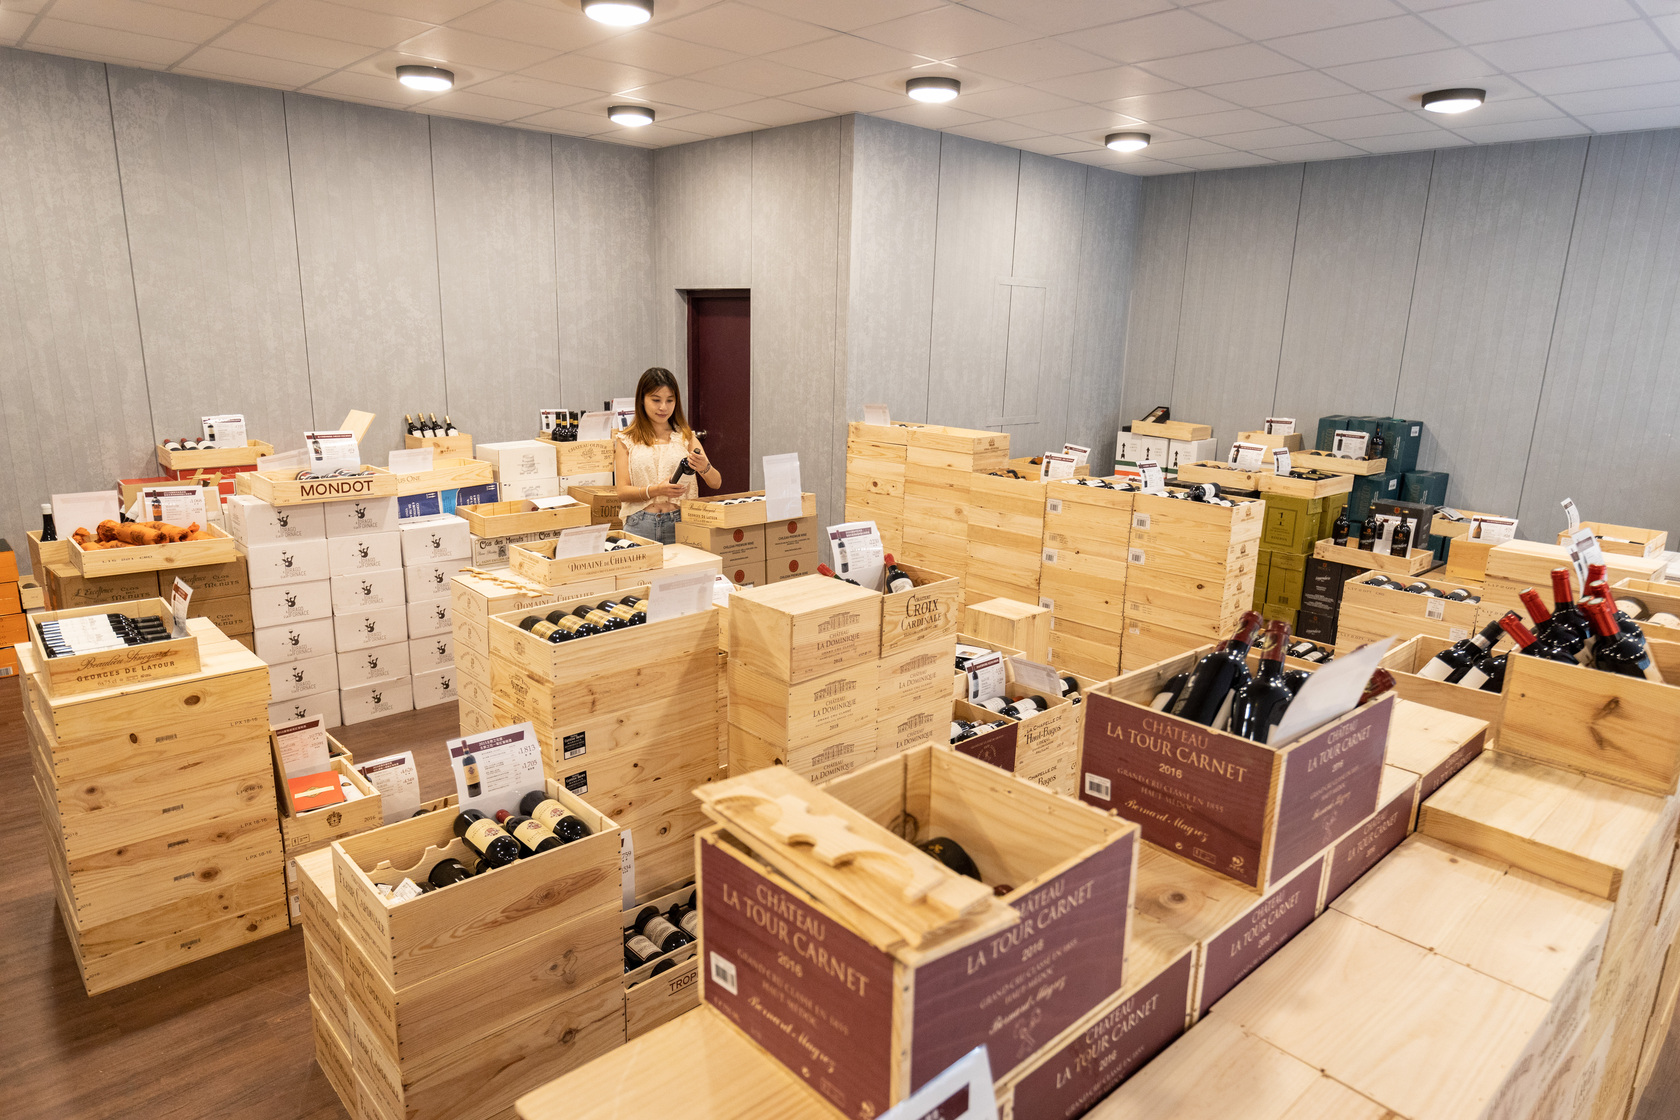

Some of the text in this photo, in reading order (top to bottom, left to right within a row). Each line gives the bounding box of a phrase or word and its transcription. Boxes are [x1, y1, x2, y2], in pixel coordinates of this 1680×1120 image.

[300, 480, 374, 496] MONDOT
[568, 560, 602, 572] DOMAINE
[610, 554, 647, 565] CHEVALIER
[906, 594, 939, 618] CROIX
[901, 613, 941, 631] CARDINALE
[826, 632, 860, 648] DOMINIQUE
[76, 671, 120, 682] GEORGES
[141, 661, 175, 671] LATOUR
[907, 672, 936, 686] DOMINIQUE
[822, 698, 856, 714] DOMINIQUE
[1033, 717, 1056, 731] CHAPELLE
[1142, 717, 1208, 749] CHÂTEAU
[904, 730, 933, 746] DOMINIQUE
[1107, 722, 1248, 782] LA TOUR CARNET
[1307, 725, 1372, 773] LA TOUR CARNET
[811, 761, 854, 782] LA DOMINIQUE
[1117, 768, 1145, 784] GRAND
[1159, 763, 1183, 779] 2016
[756, 884, 826, 941] CHÂTEAU
[967, 880, 1095, 976] LA TOUR CARNET
[1230, 890, 1300, 957] LA TOUR CARNET
[723, 883, 869, 997] LA TOUR CARNET
[777, 951, 803, 978] 2016
[669, 972, 698, 992] TROP
[1056, 1067, 1072, 1089] LA
[1075, 1035, 1110, 1072] TOUR
[1111, 994, 1159, 1041] CARNET
